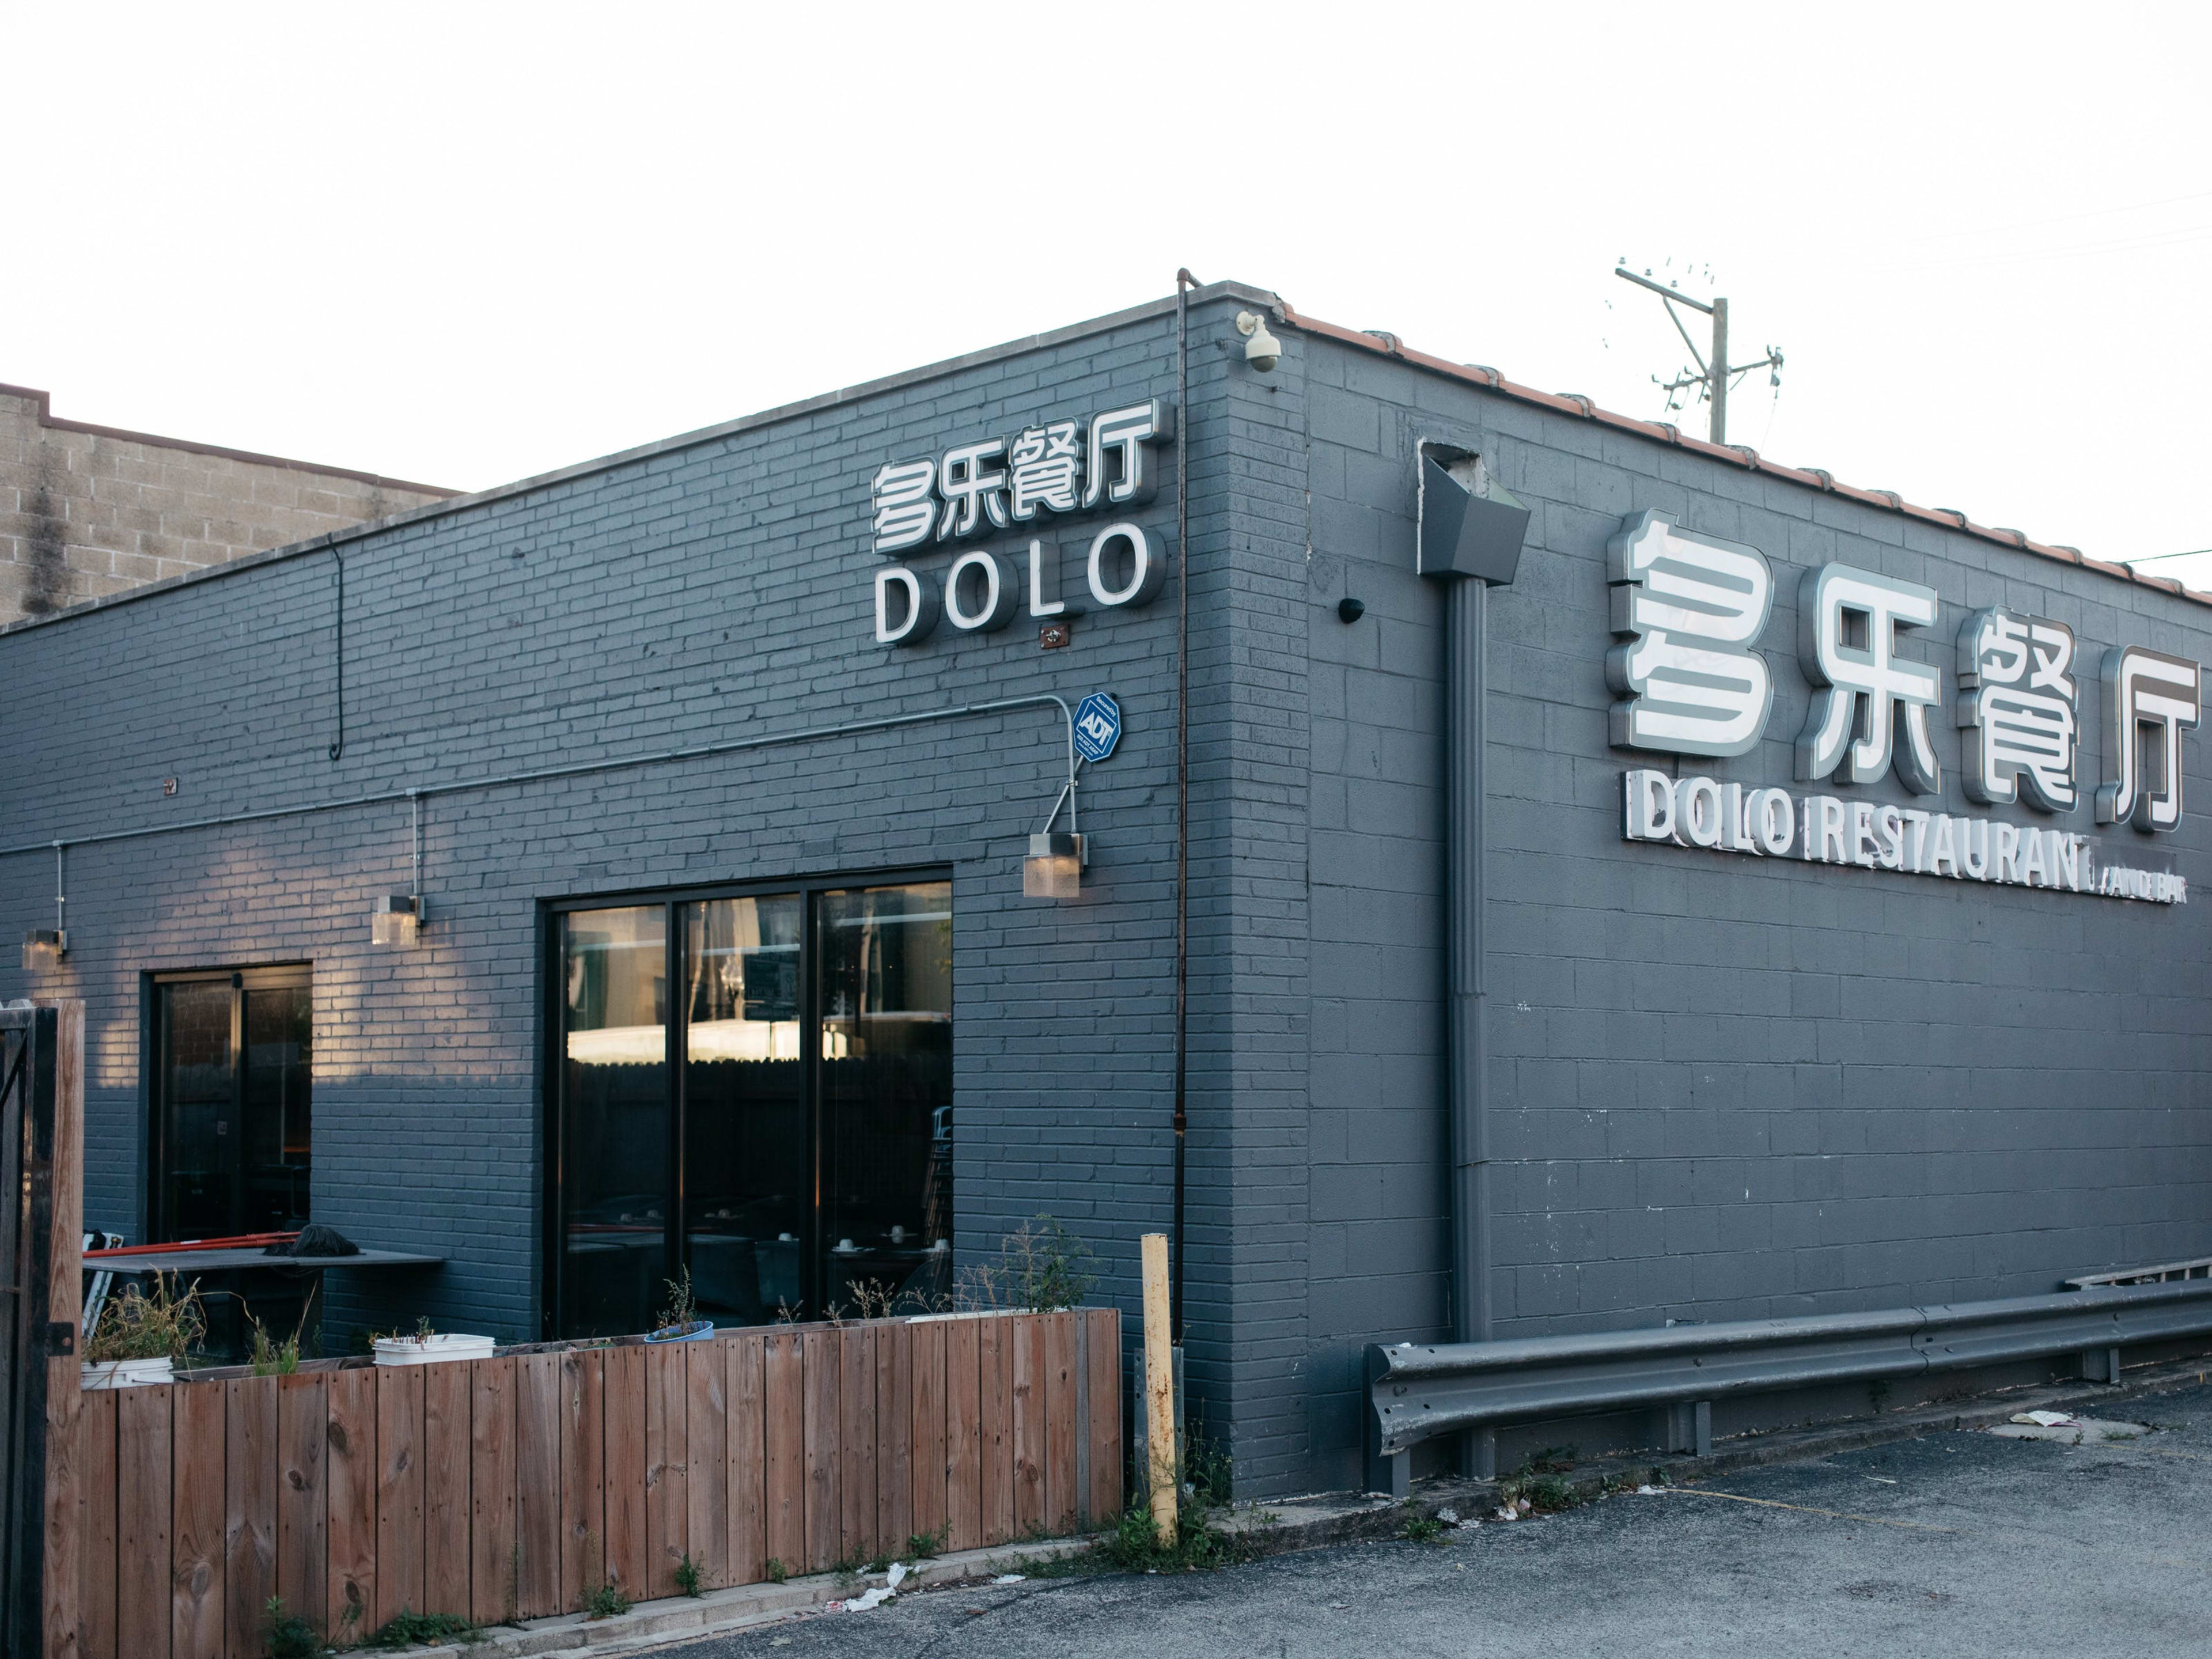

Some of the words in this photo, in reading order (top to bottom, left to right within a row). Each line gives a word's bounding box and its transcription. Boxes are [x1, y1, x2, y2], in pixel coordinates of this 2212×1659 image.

[872, 398, 1160, 553] 多乐餐厅
[875, 522, 1151, 643] DOLO
[1080, 711, 1114, 746] ADT
[1613, 509, 2200, 833] 多乐餐厅
[1626, 769, 1795, 855] DOLO
[2101, 865, 2152, 899] AND
[2151, 872, 2187, 904] BAR
